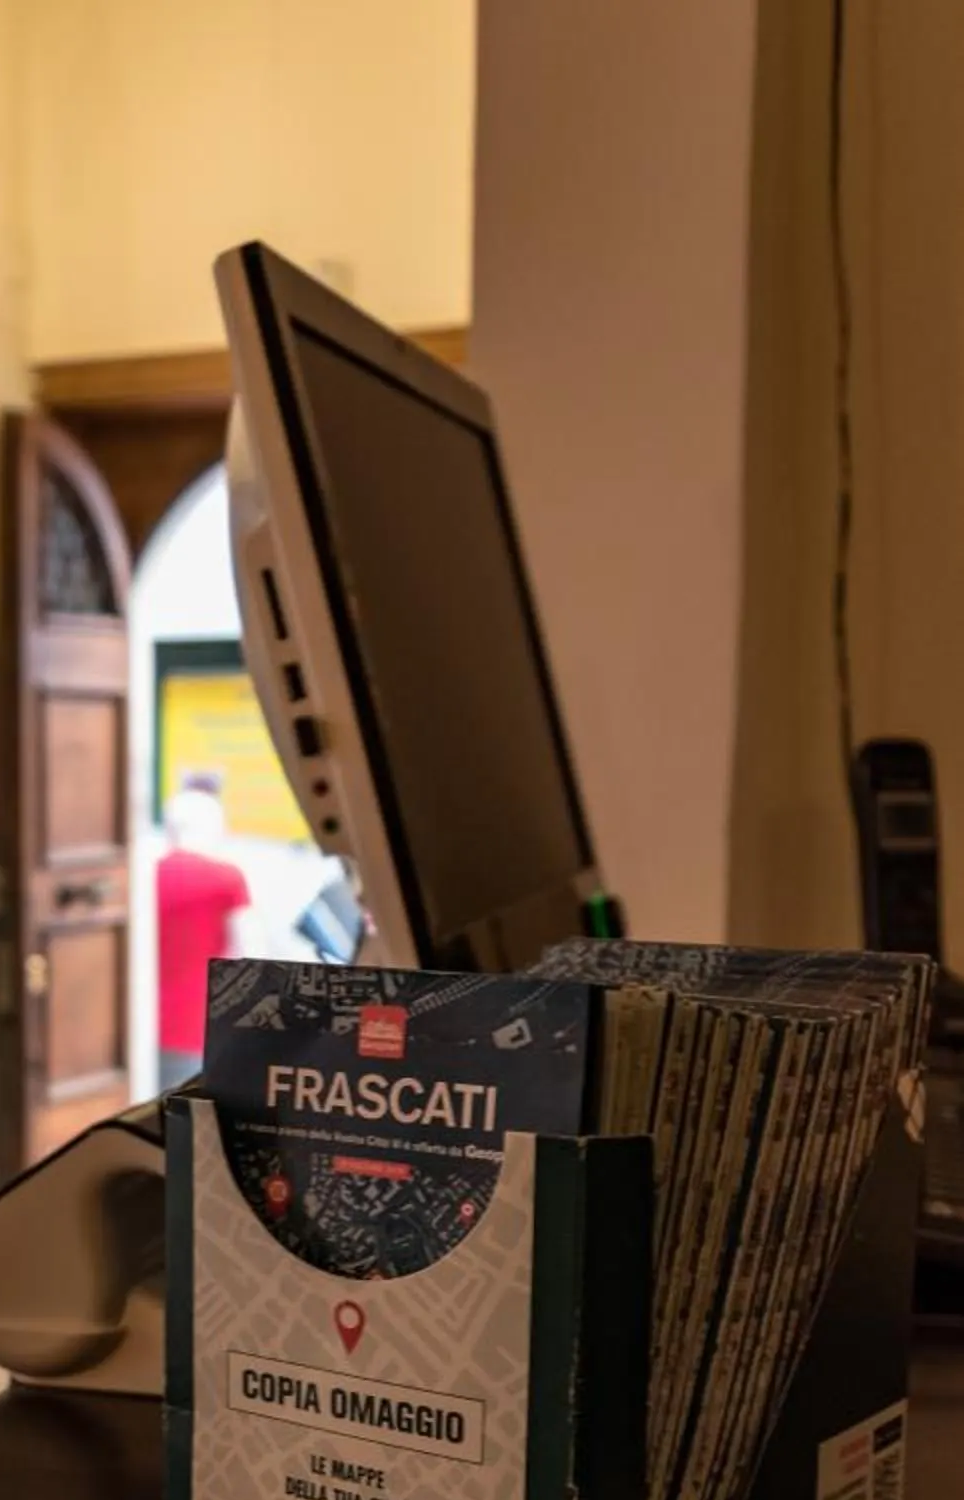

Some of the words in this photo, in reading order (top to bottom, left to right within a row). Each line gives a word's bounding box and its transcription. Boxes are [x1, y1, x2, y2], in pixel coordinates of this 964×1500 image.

[266, 1065, 498, 1132] FRASCATI
[242, 1368, 321, 1415] COPIA
[330, 1387, 465, 1445] OMAGGIO
[310, 1454, 326, 1476] LE
[331, 1463, 385, 1491] MAPPE
